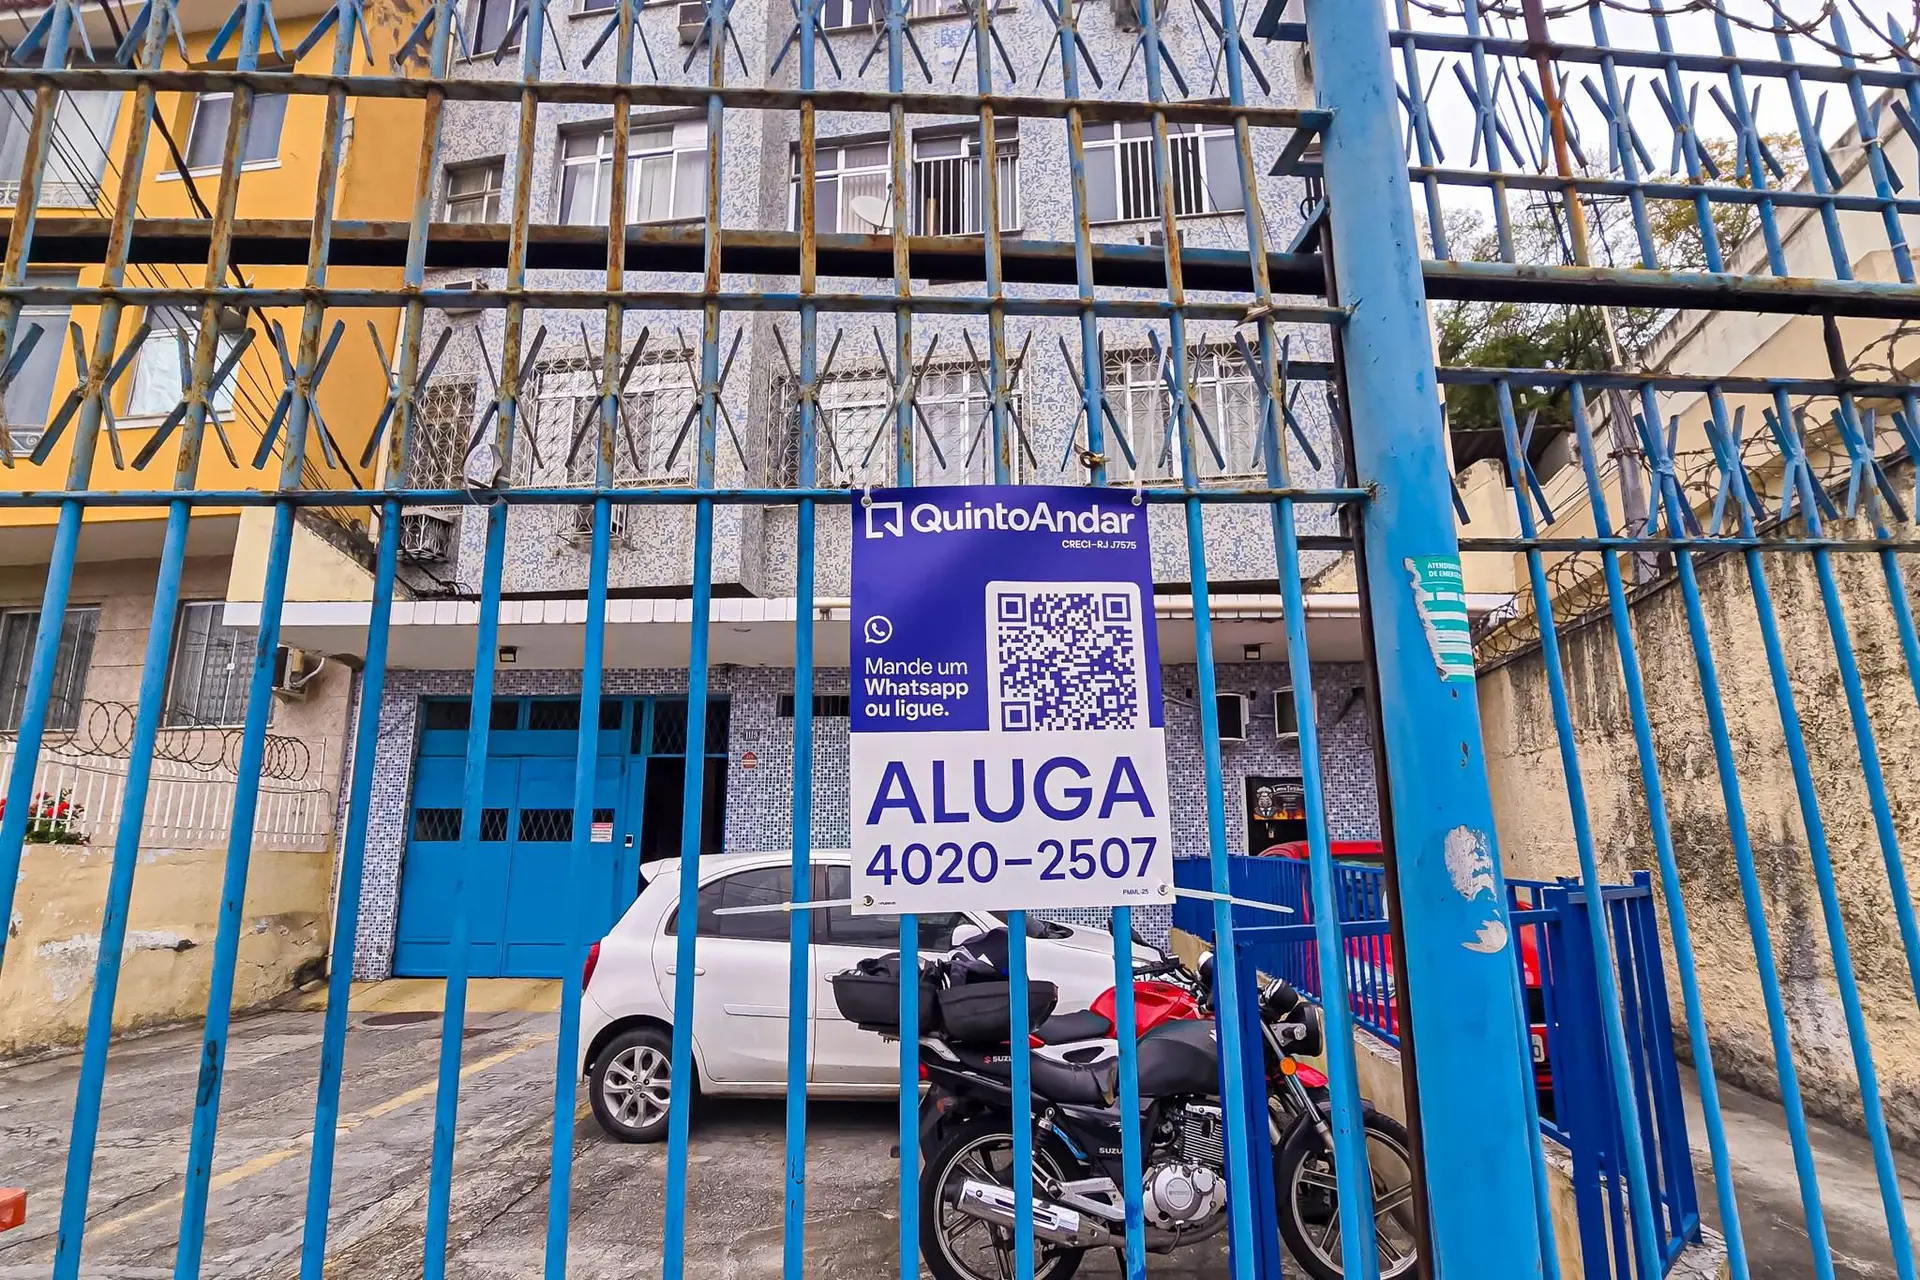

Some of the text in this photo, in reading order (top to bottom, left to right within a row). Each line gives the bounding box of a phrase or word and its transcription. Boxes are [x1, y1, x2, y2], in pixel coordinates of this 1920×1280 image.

[911, 502, 1135, 534] QuintoAndar
[1062, 539, 1137, 550] CRECI-RJ J7575
[865, 657, 968, 675] Mande um
[864, 678, 969, 700] Whatsapp
[865, 700, 950, 720] ou ligue.
[866, 757, 1155, 825] ALUGA
[866, 837, 1157, 885] 4020-2507
